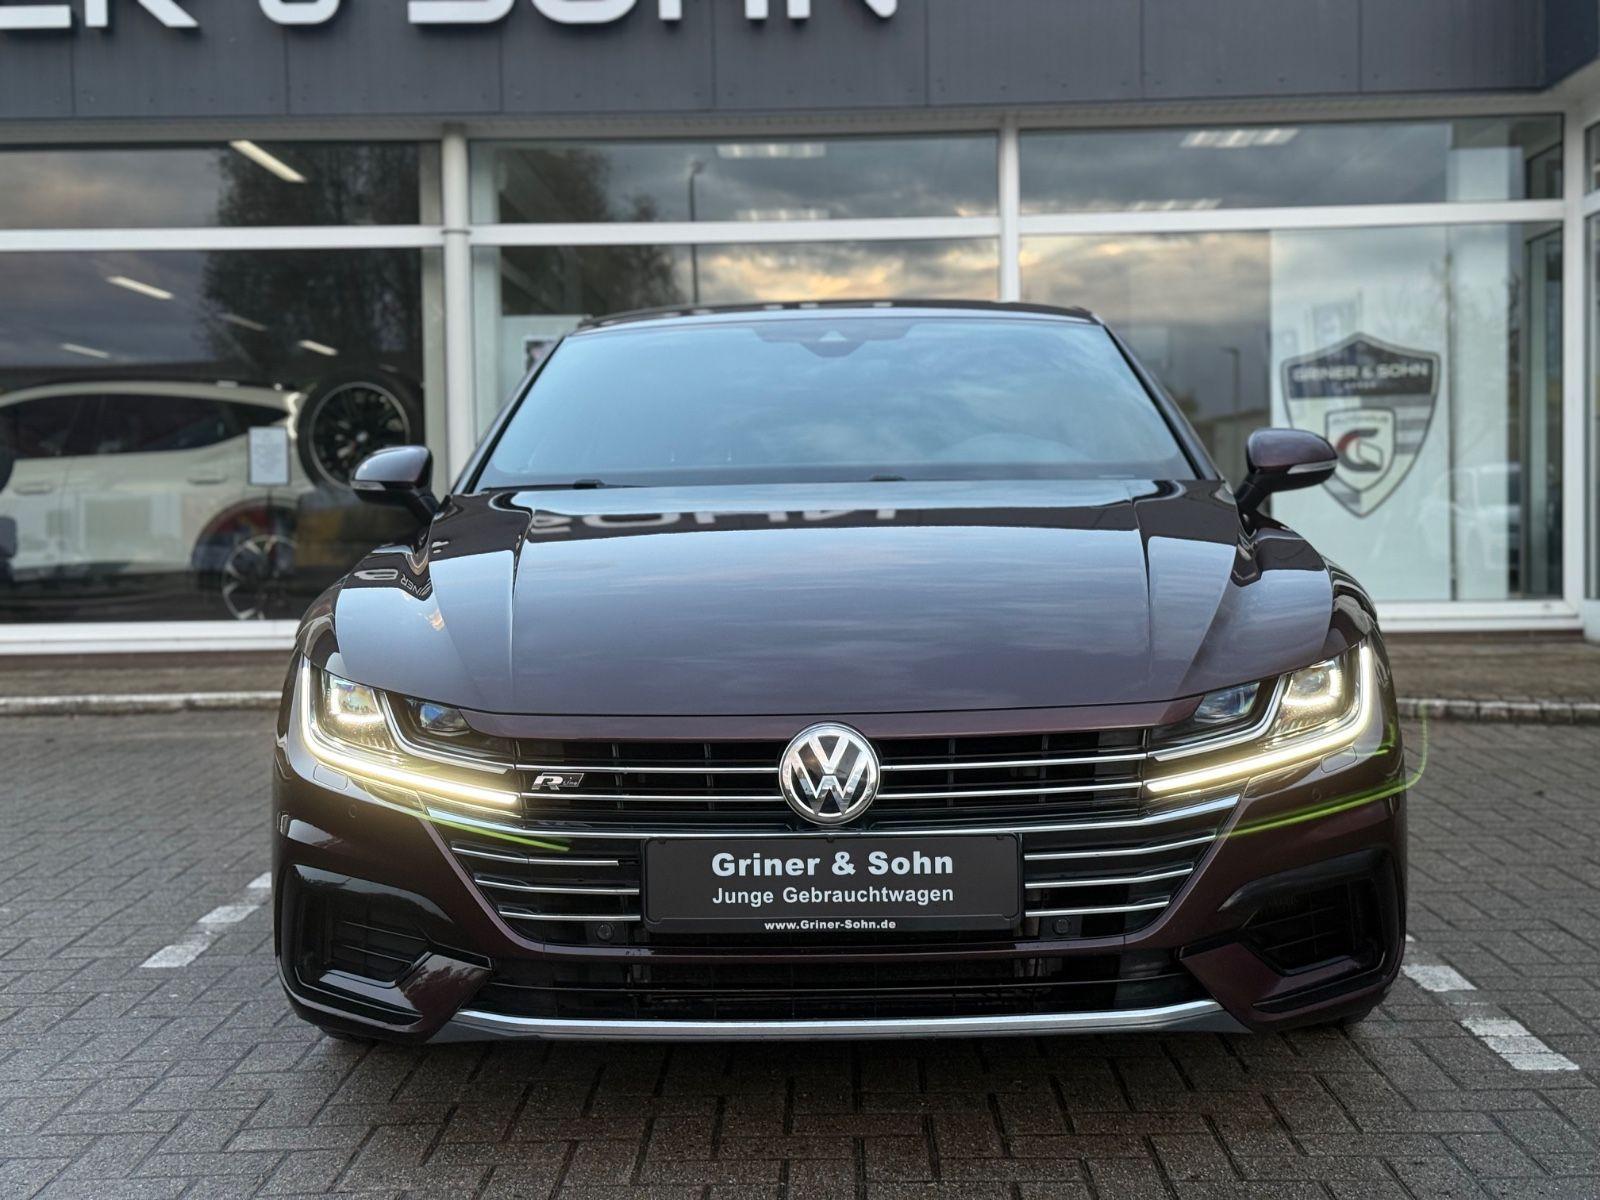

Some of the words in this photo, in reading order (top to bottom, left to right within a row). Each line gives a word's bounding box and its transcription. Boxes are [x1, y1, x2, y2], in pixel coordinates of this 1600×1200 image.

[1376, 362, 1429, 379] SOHN
[711, 852, 821, 877] Griner
[831, 851, 856, 876] &
[868, 850, 953, 875] Sohn
[712, 887, 774, 907] Junge
[782, 886, 954, 906] Gebrauchtwagen
[764, 919, 897, 931] www.Griner-Sohn.de
